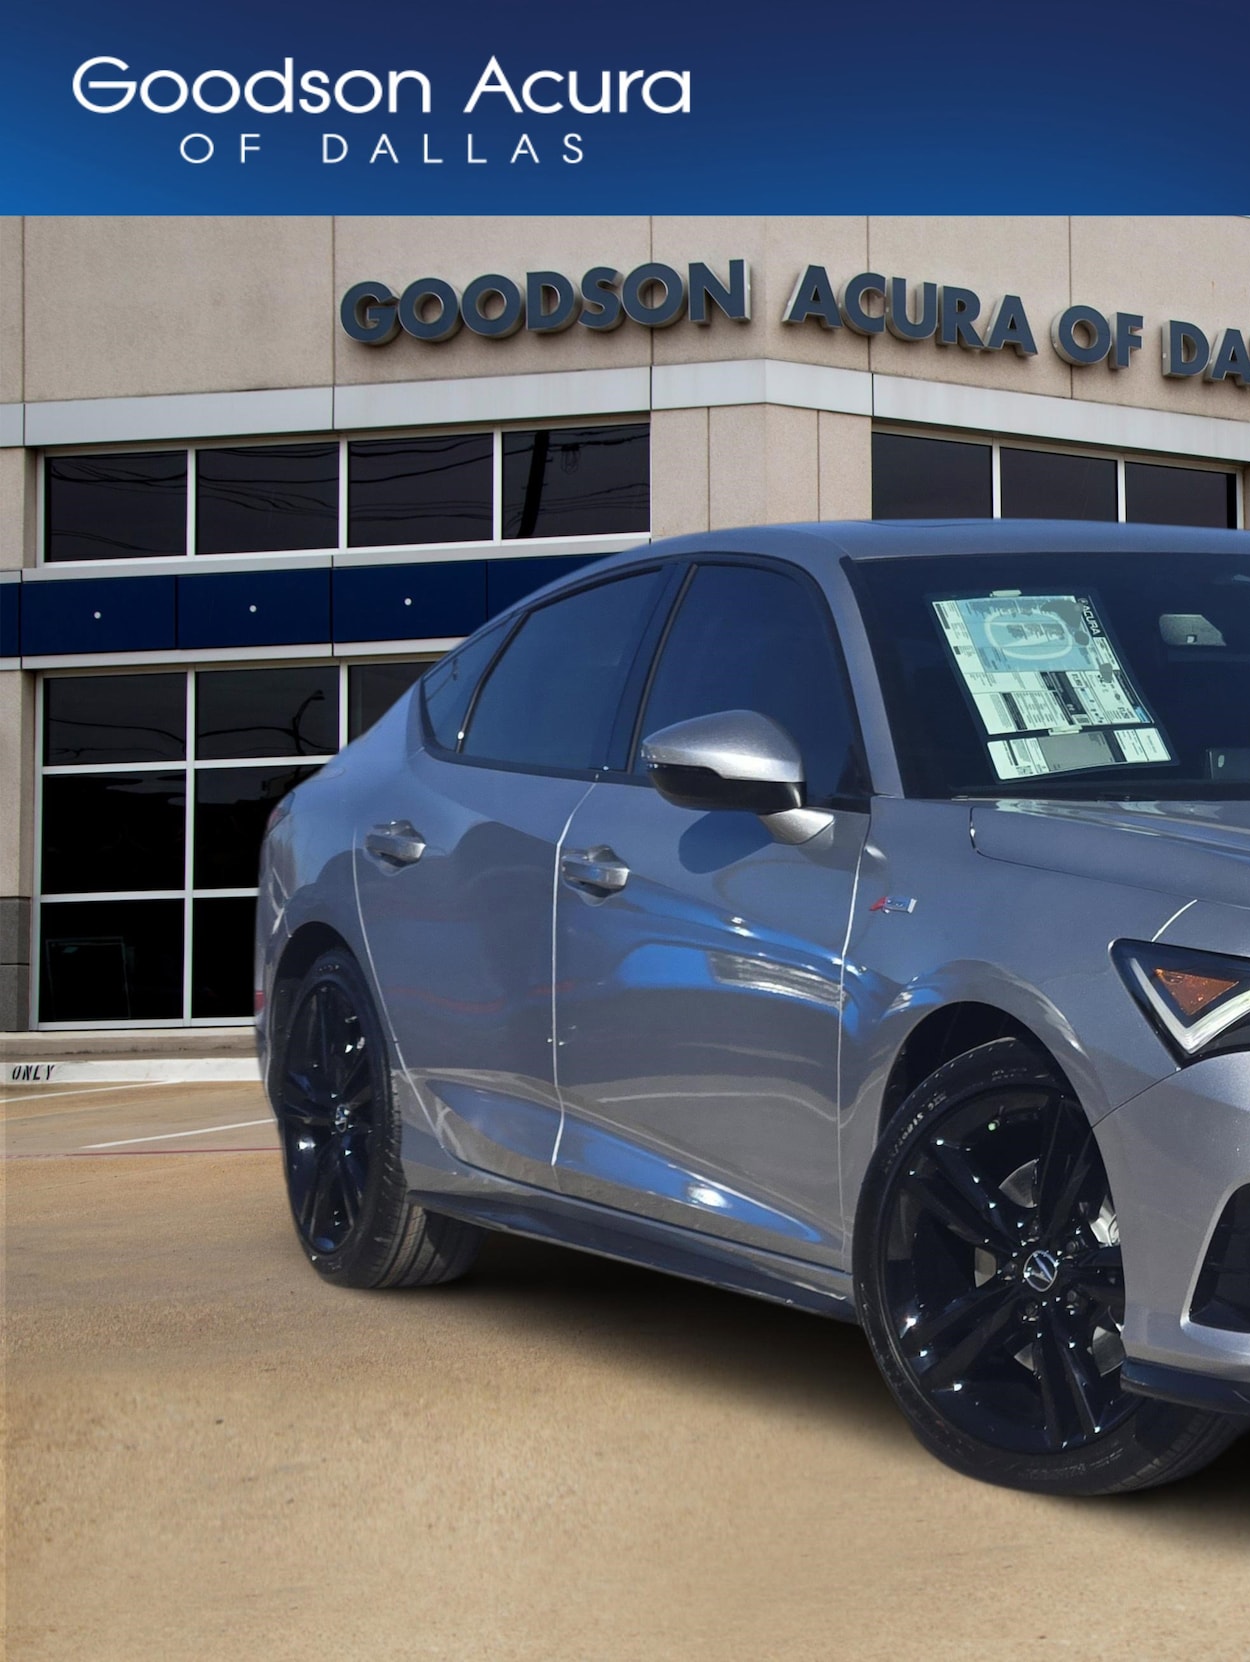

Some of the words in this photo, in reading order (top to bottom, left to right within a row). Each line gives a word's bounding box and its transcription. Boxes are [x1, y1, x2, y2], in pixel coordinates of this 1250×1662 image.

[340, 259, 751, 345] GOODSON
[781, 264, 1038, 358] ACURA
[1051, 305, 1144, 370] OF
[1082, 604, 1101, 636] ACURA
[12, 1064, 55, 1081] ONLY
